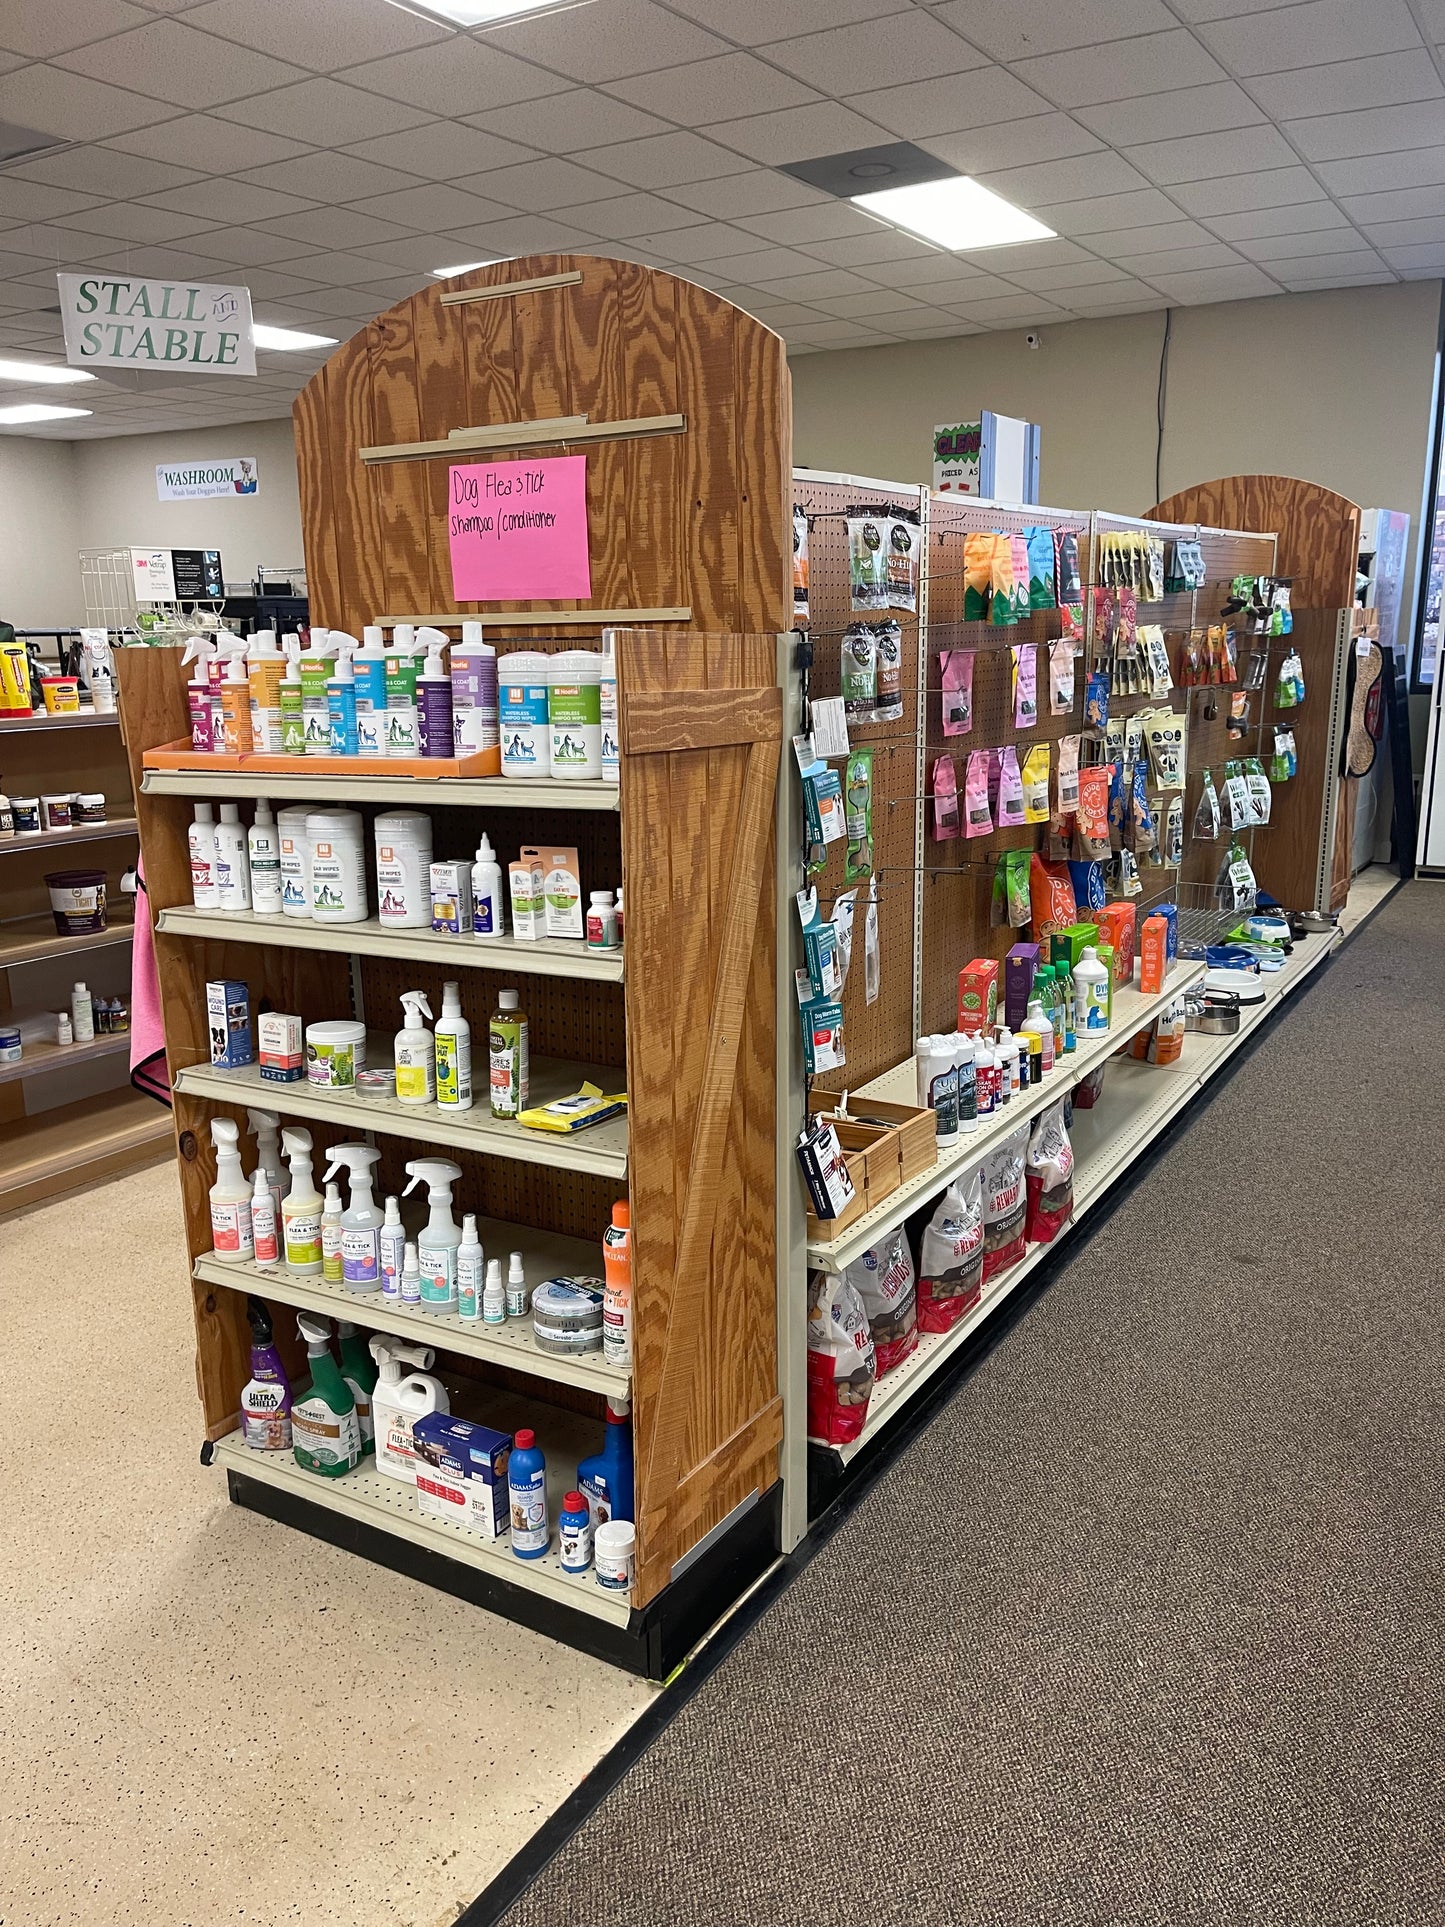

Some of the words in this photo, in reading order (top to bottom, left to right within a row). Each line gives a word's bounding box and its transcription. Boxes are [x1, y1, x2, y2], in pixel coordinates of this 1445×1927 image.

[76, 280, 207, 321] STALL
[212, 299, 239, 316] AND
[80, 322, 240, 365] STABLE
[164, 468, 234, 486] WASHROOM
[941, 469, 963, 478] PRICED
[968, 468, 978, 476] AS
[454, 470, 479, 508] Dog
[486, 472, 512, 498] Flea
[614, 1297, 630, 1308] TICK
[440, 1457, 461, 1468] ADAMS
[443, 1466, 461, 1476] PLUS
[582, 1480, 604, 1496] ADAMS
